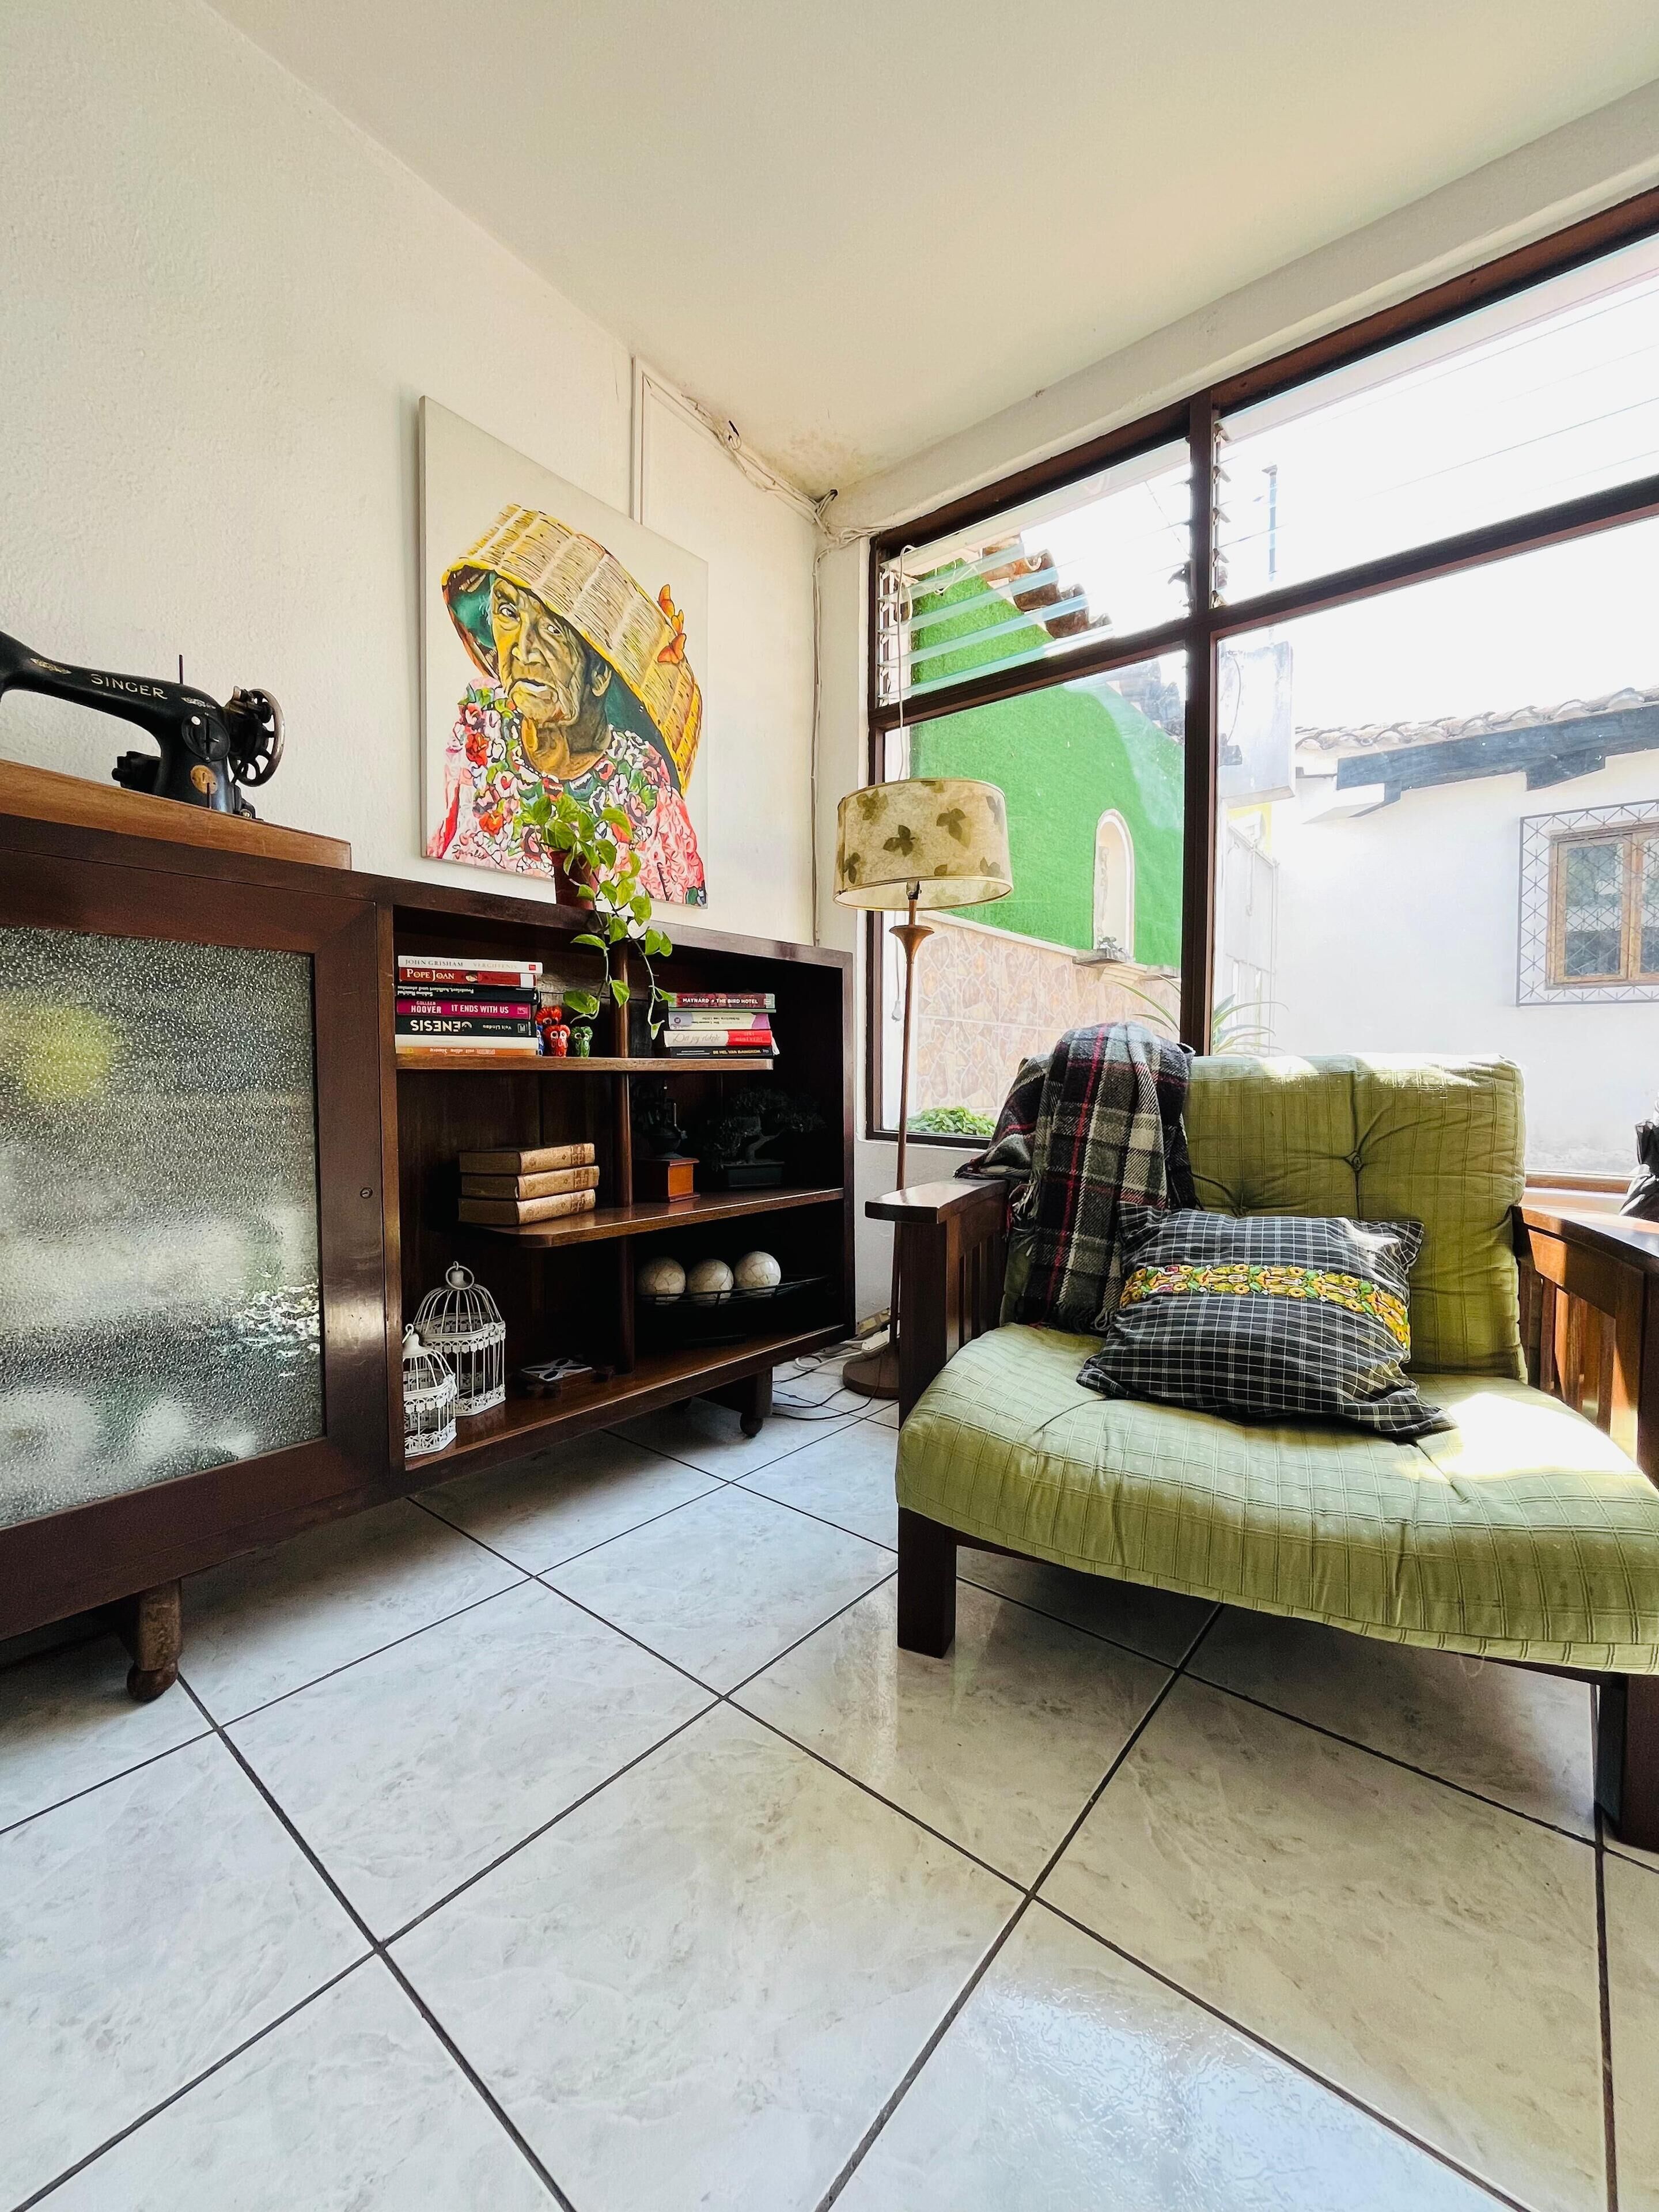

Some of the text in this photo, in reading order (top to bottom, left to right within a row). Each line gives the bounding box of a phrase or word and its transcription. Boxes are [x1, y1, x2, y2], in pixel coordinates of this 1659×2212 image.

[90, 673, 168, 699] SINGER
[406, 968, 454, 982] POPE JOAN
[411, 1005, 442, 1014] HOOVER
[451, 1004, 509, 1014] IT ENDS WITH US
[410, 1020, 472, 1032] GENESIS
